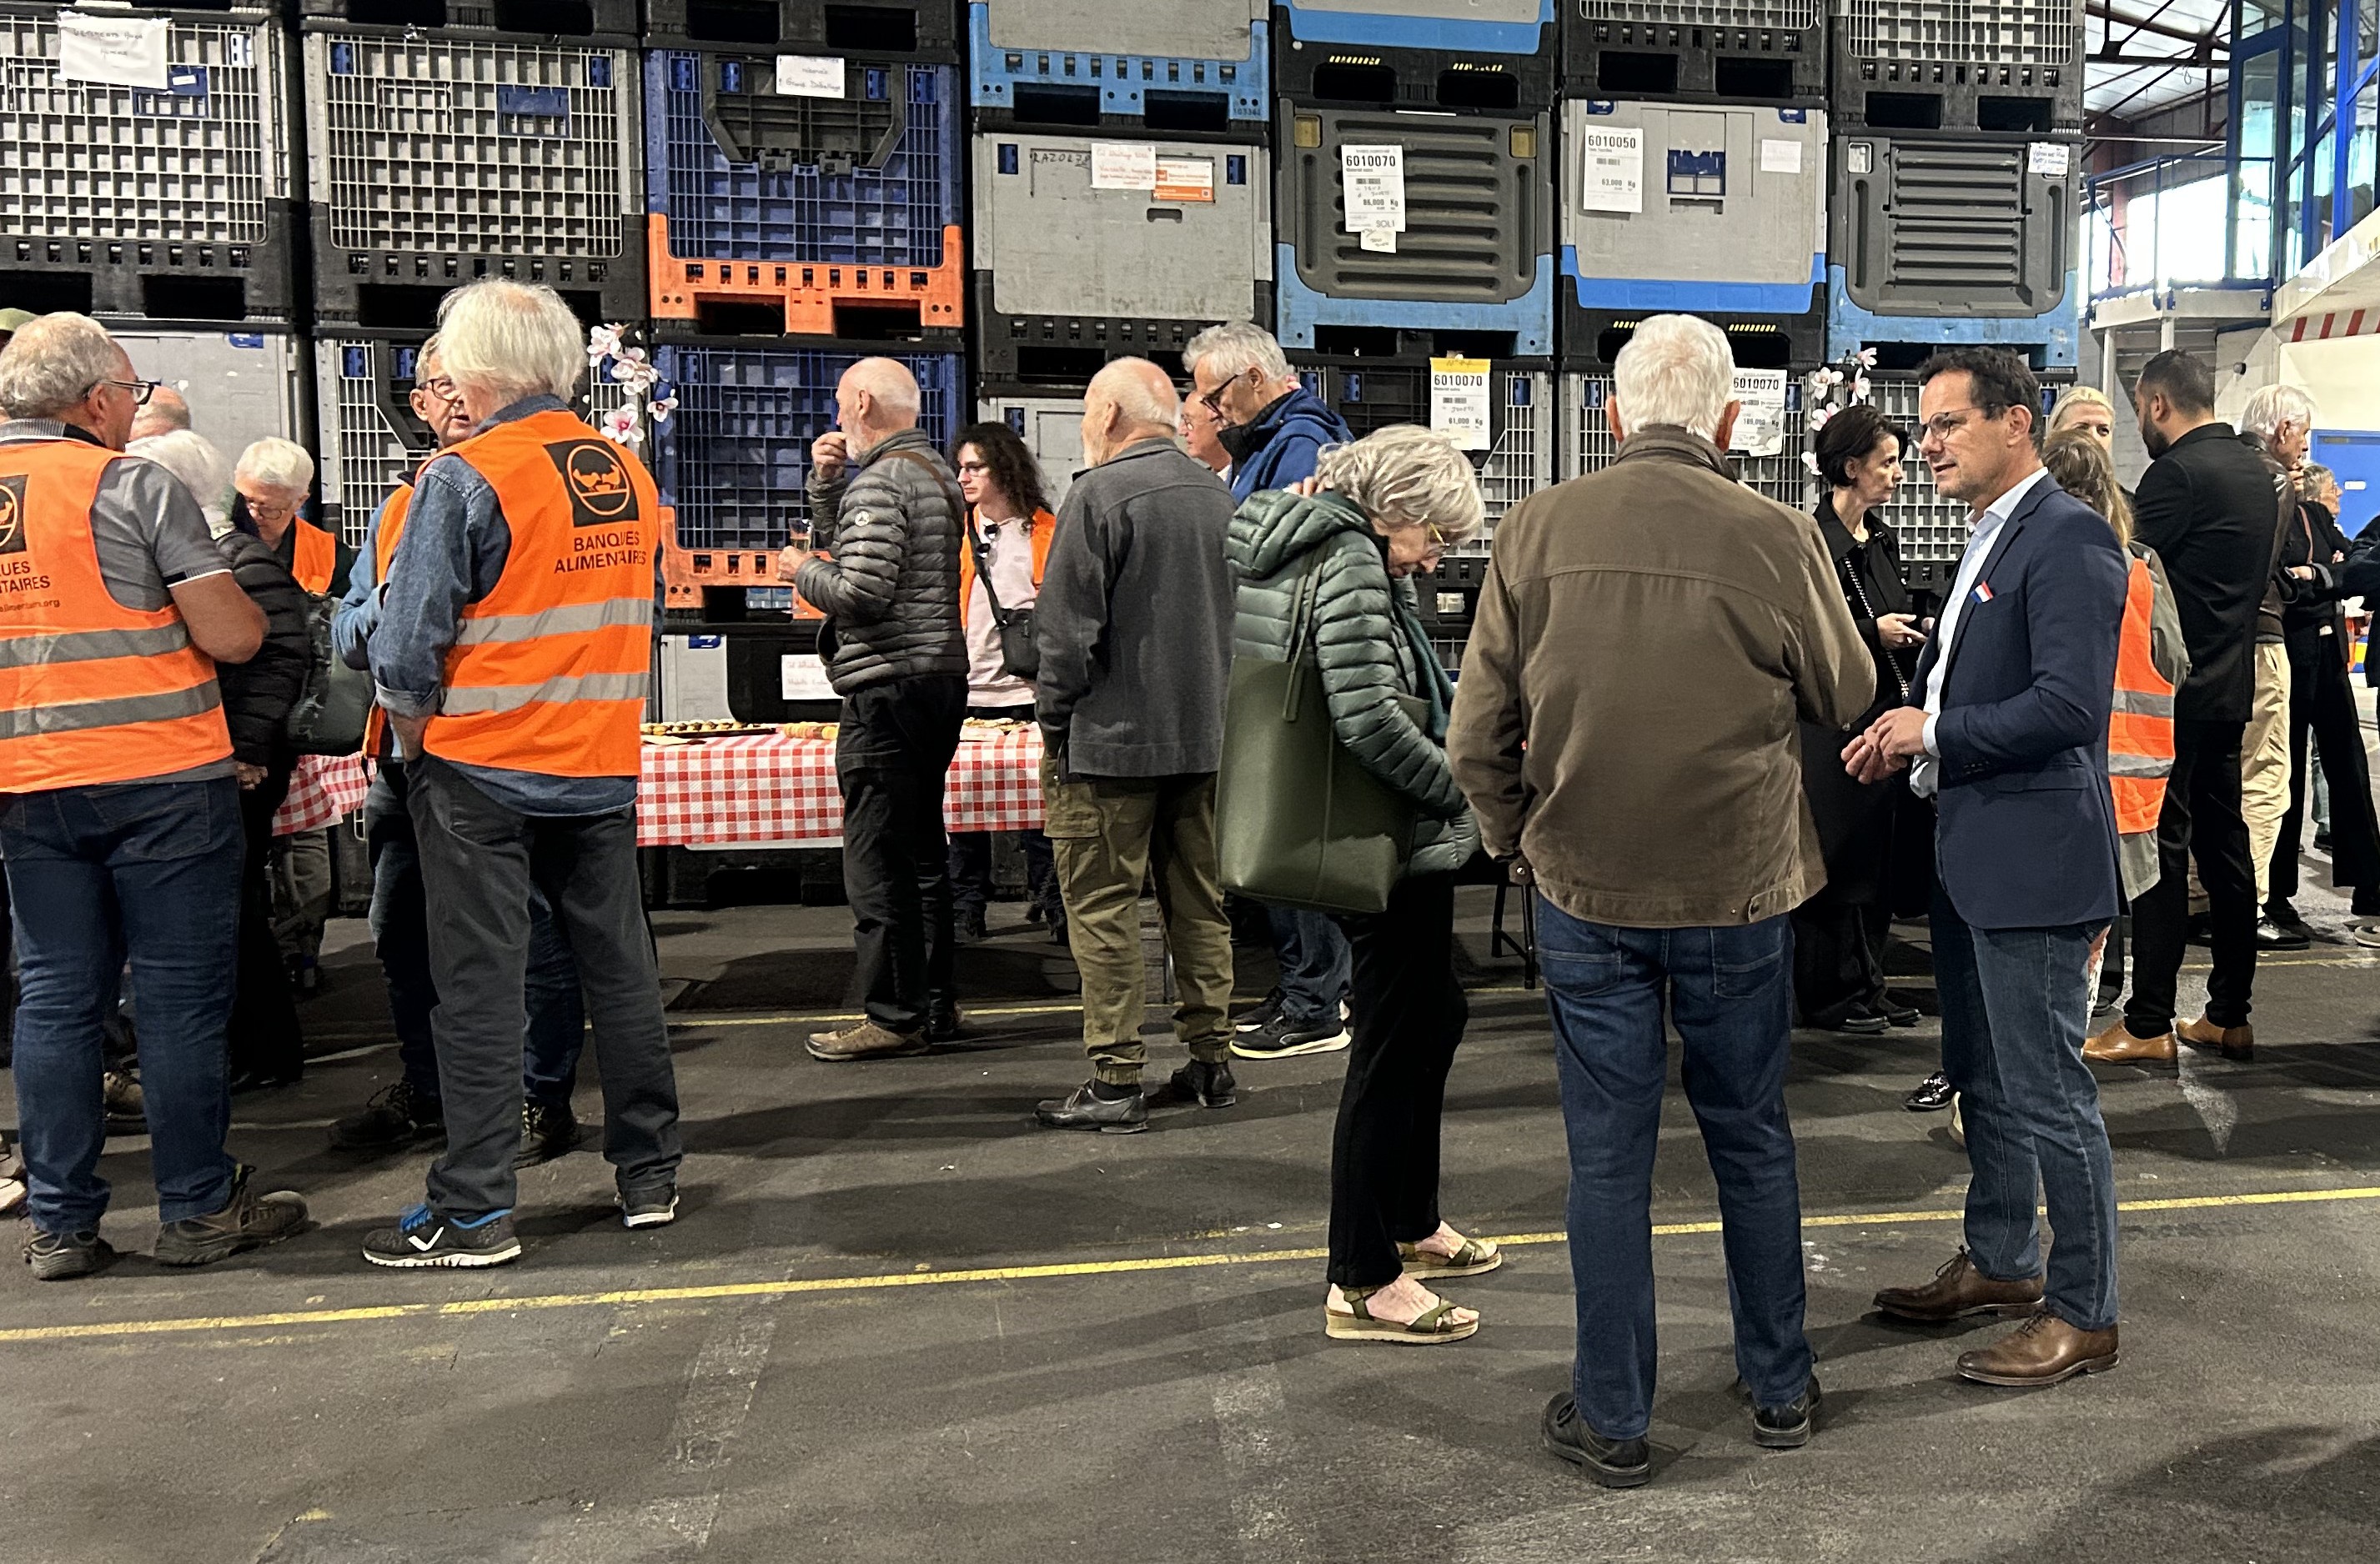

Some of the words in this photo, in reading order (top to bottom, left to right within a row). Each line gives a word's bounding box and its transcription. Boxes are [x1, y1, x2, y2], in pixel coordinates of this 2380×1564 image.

[1588, 135, 1636, 148] 6010050
[1346, 155, 1396, 167] 6010070
[1628, 180, 1636, 188] Kg
[1434, 374, 1483, 386] 6010070
[1733, 378, 1779, 390] 6010070
[574, 531, 640, 552] BANQUES
[0, 561, 31, 577] UES
